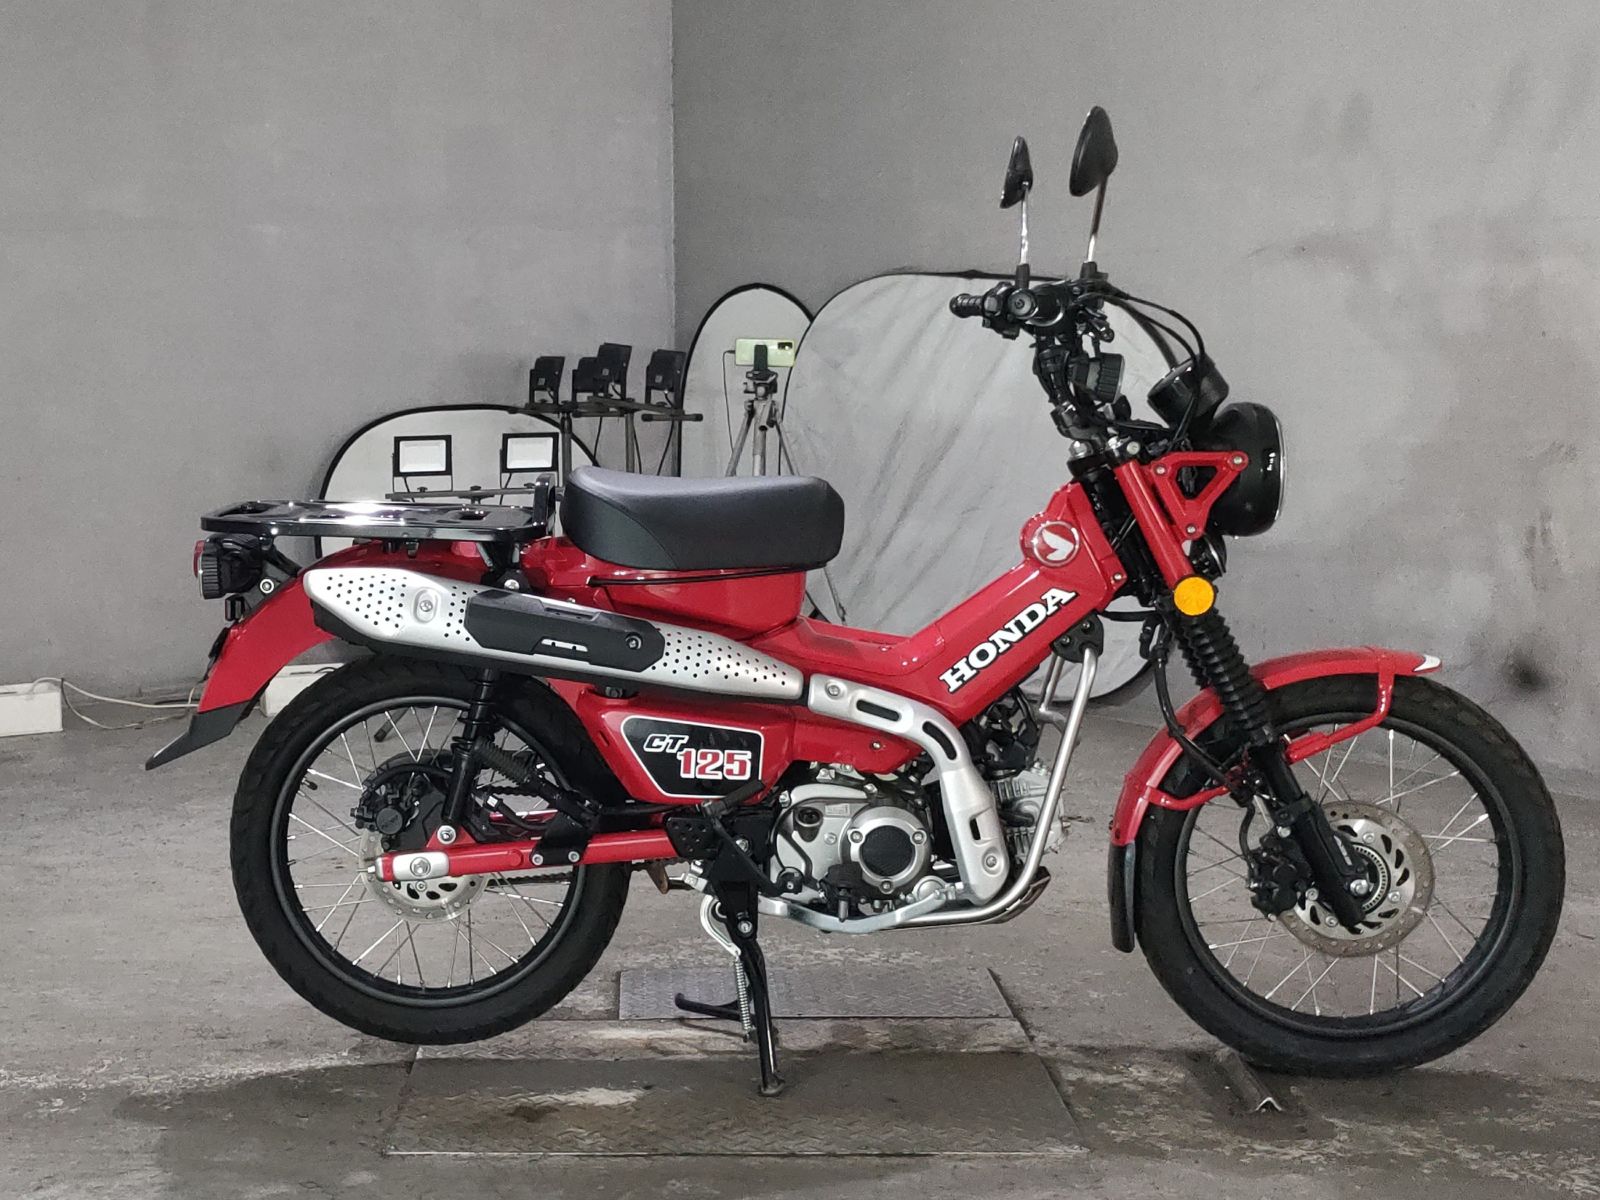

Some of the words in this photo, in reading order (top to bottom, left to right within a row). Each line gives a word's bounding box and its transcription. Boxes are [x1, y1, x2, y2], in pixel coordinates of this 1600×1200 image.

[938, 588, 1077, 693] HONDA
[643, 733, 689, 753] CT
[677, 748, 752, 780] 125
